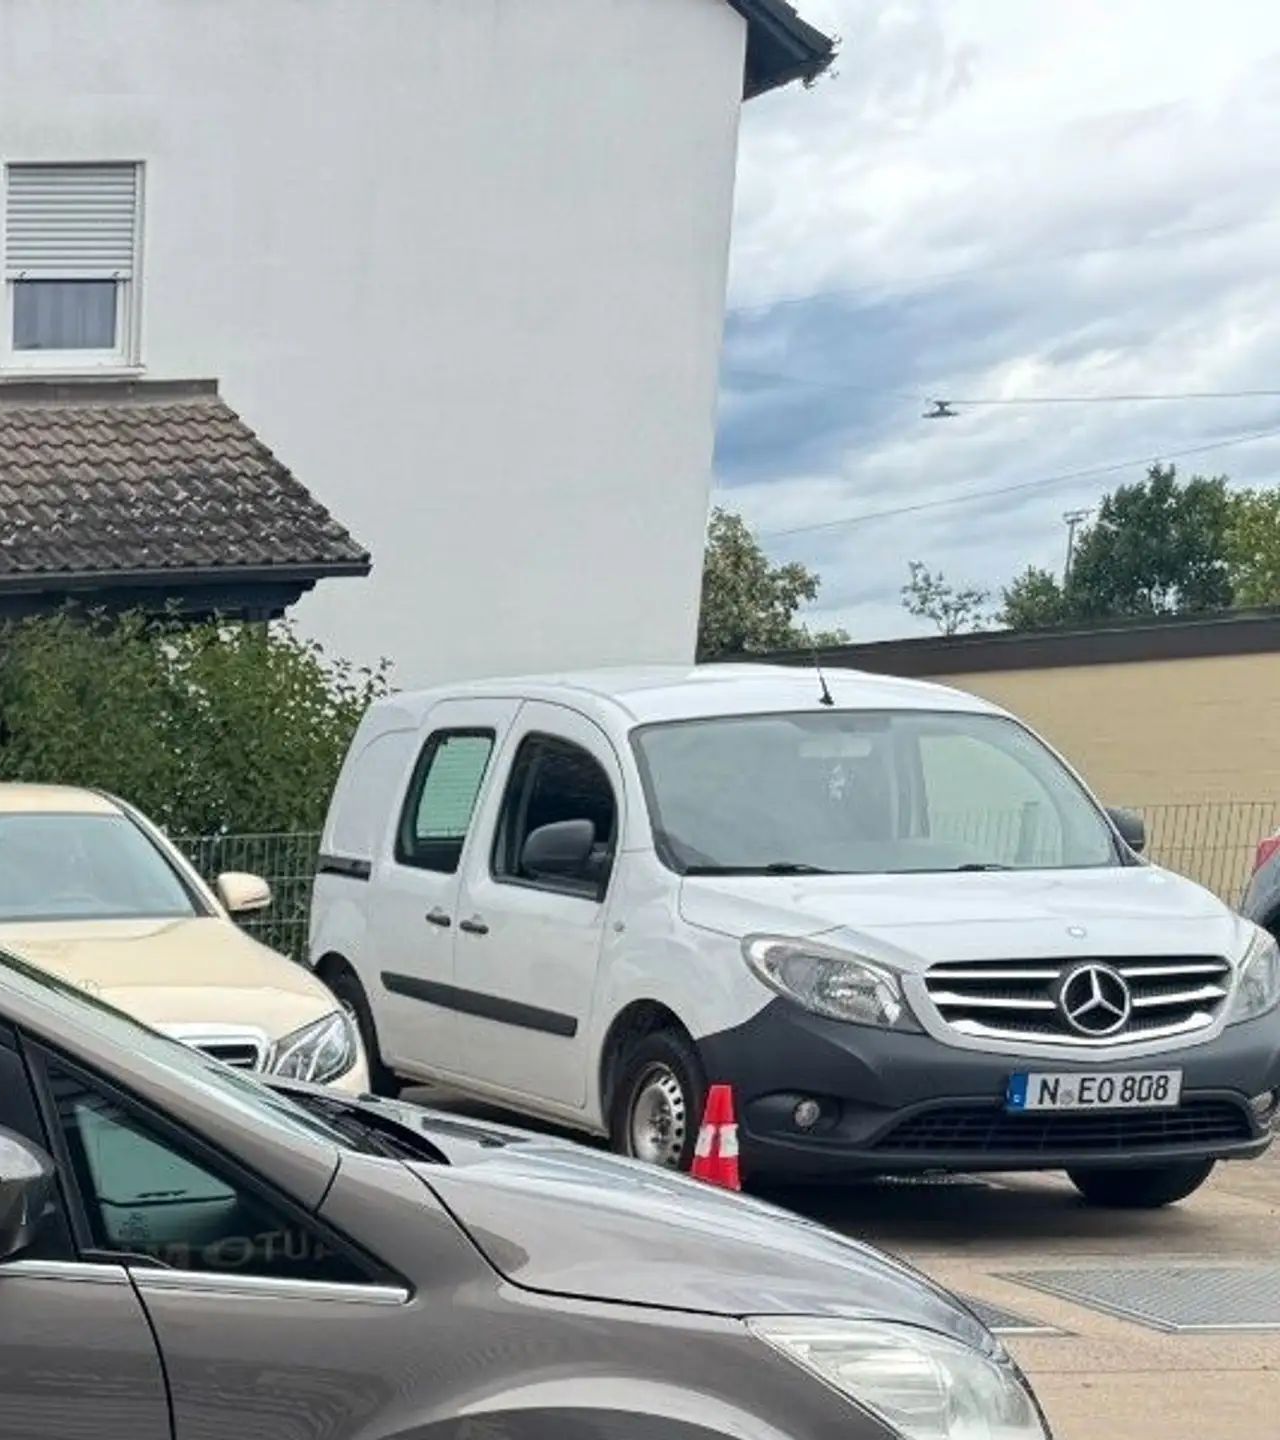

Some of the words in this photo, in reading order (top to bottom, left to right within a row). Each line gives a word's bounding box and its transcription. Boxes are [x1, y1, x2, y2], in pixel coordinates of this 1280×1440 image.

[1038, 1078, 1060, 1105] N
[1079, 1077, 1114, 1104] EO
[1120, 1075, 1171, 1103] 808
